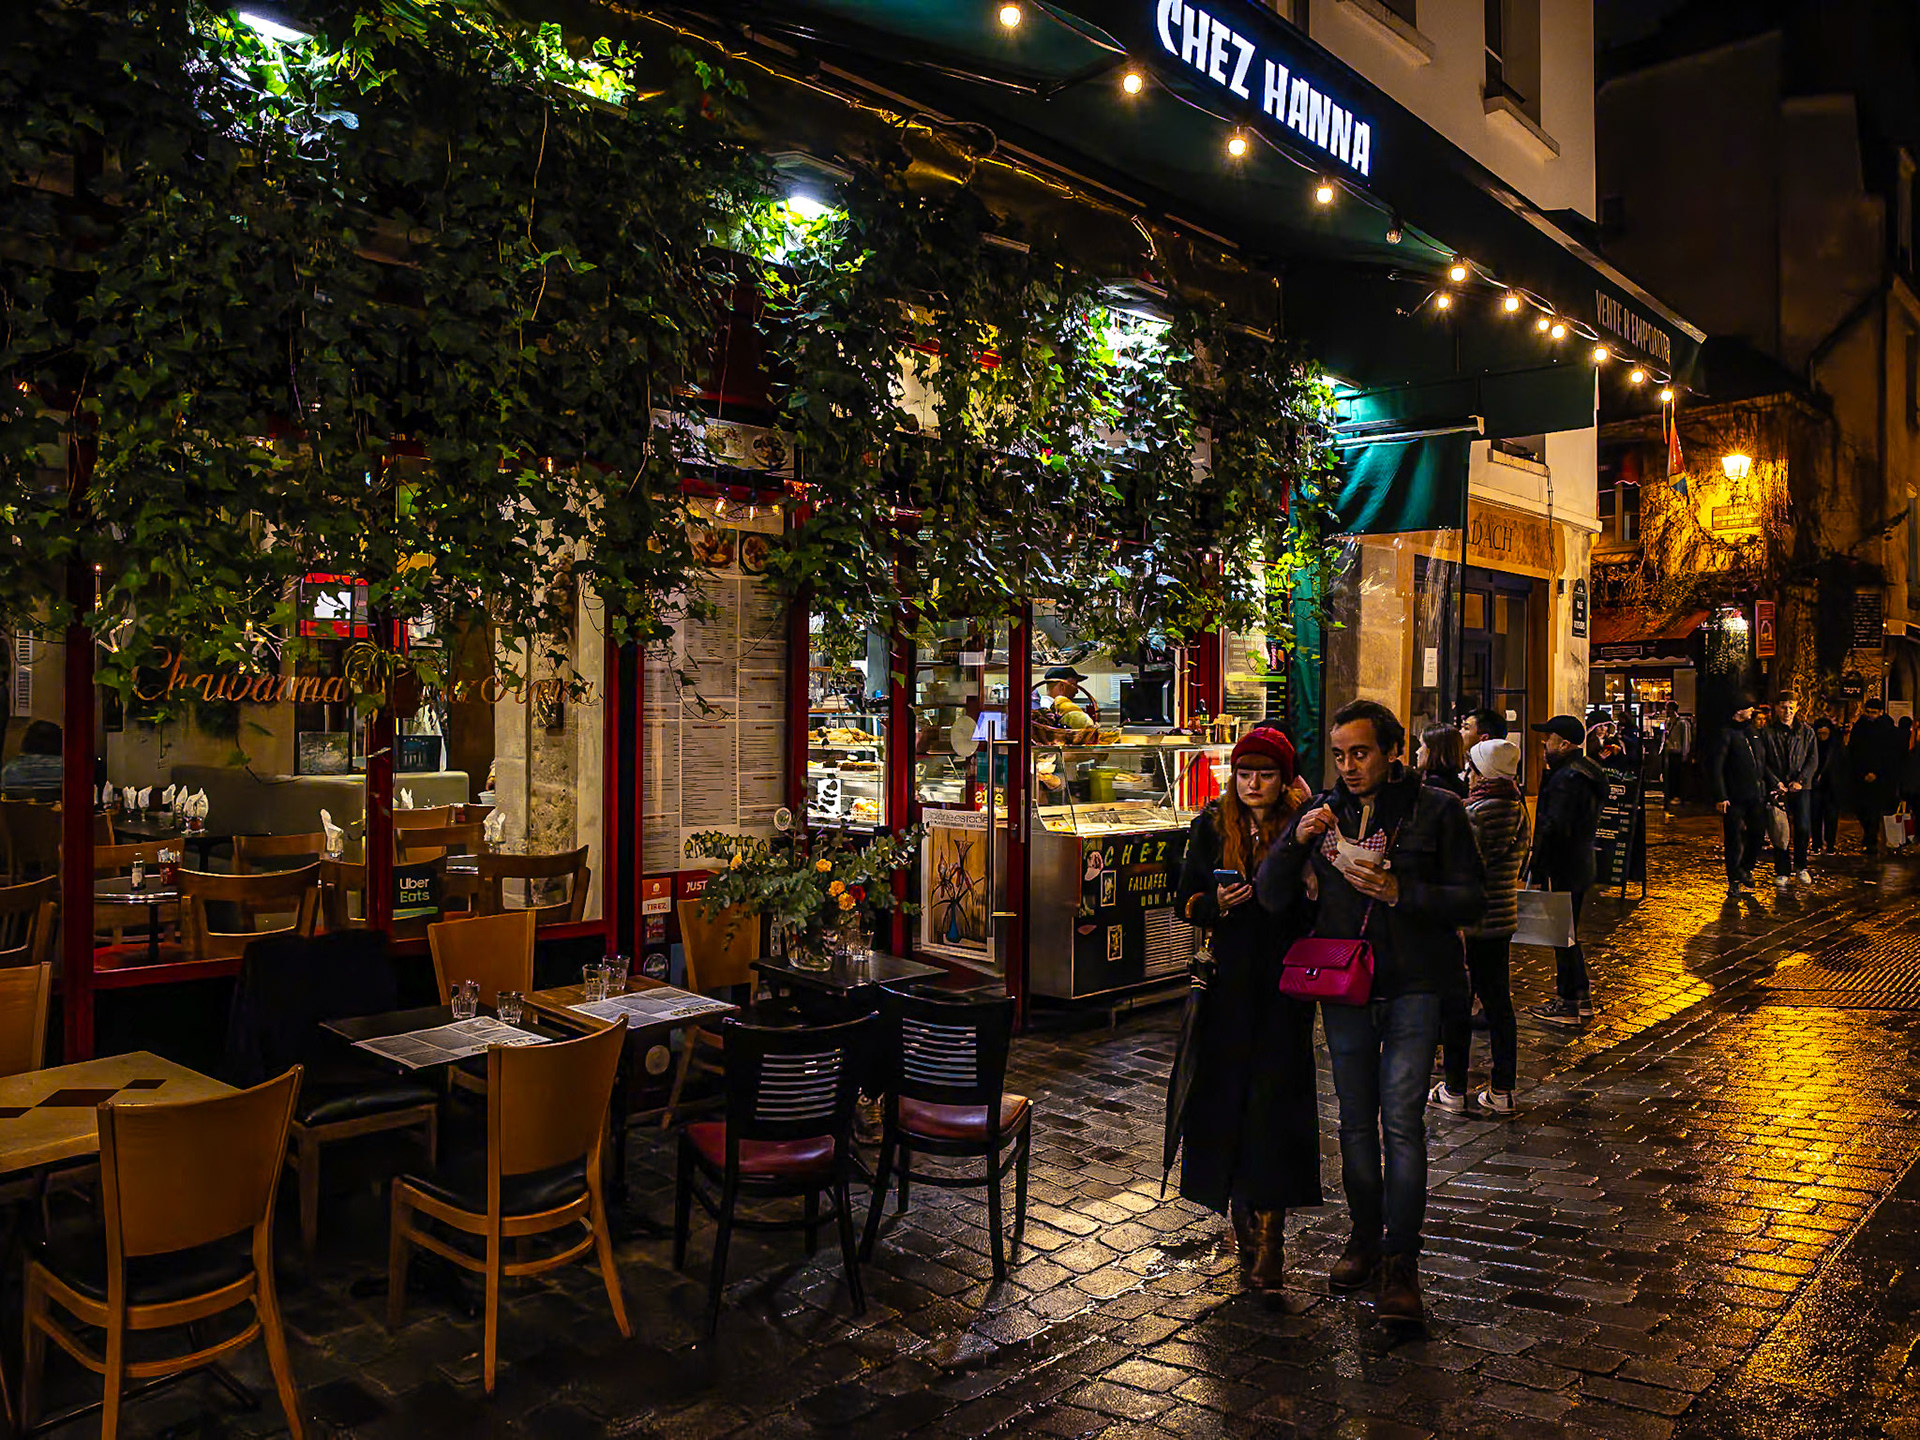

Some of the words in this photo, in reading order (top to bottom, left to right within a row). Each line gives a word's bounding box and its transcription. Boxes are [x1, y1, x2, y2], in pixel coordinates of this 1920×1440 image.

[1156, 0, 1256, 100] CHEZ
[1263, 58, 1371, 178] HANNA
[1595, 289, 1622, 336] VENTE
[1631, 311, 1671, 367] EMPORTER
[1104, 841, 1167, 867] CHEZ
[399, 877, 430, 890] Uber
[686, 880, 709, 894] JUST
[1128, 872, 1168, 892] FALLAFEL
[399, 890, 430, 904] Eats
[646, 902, 667, 912] TIREZ
